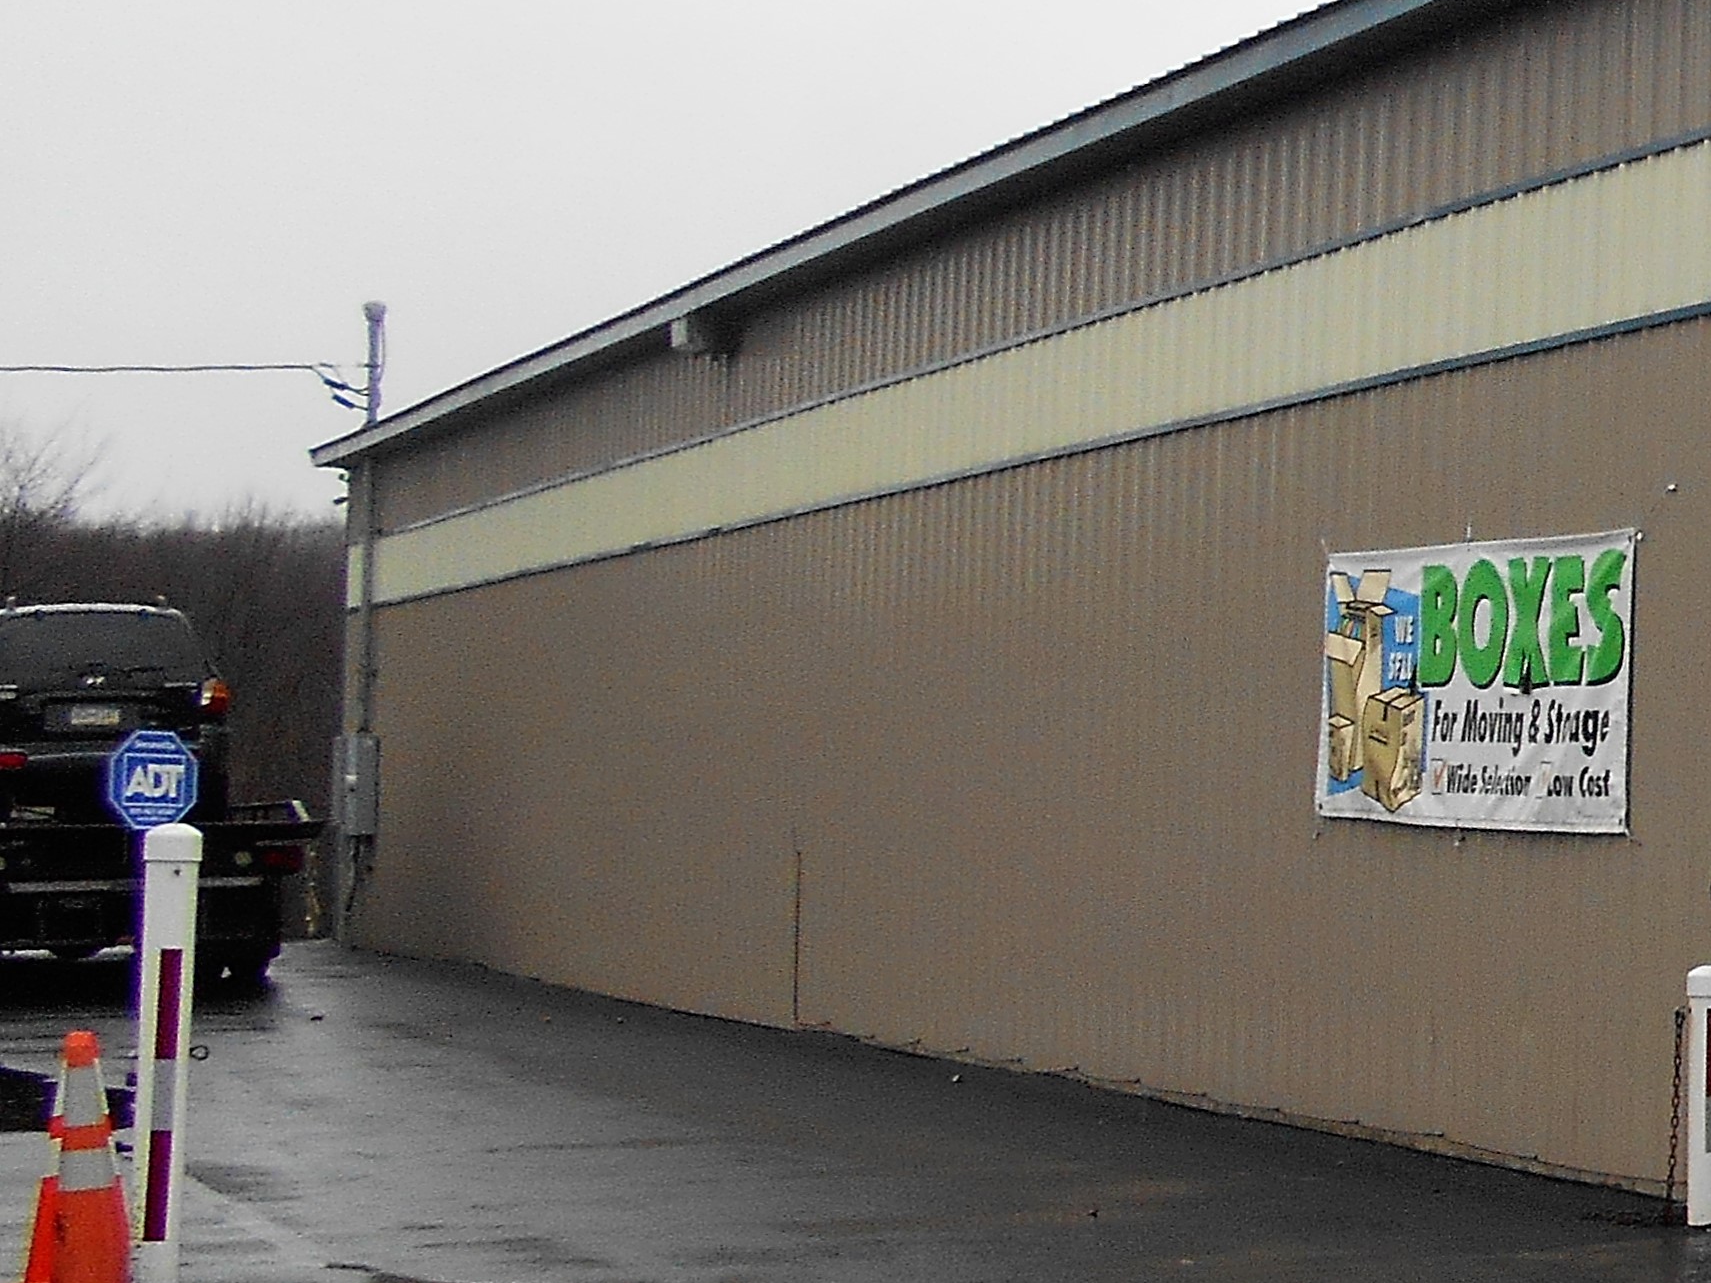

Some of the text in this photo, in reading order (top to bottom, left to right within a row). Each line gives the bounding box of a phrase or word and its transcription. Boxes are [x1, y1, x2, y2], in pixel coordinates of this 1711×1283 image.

[1416, 548, 1628, 689] BOXES
[1431, 696, 1611, 757] For Moving & Strage
[125, 763, 186, 798] ADT
[1446, 763, 1478, 794] Wide
[1546, 771, 1576, 797] Low
[1578, 765, 1611, 798] Cost
